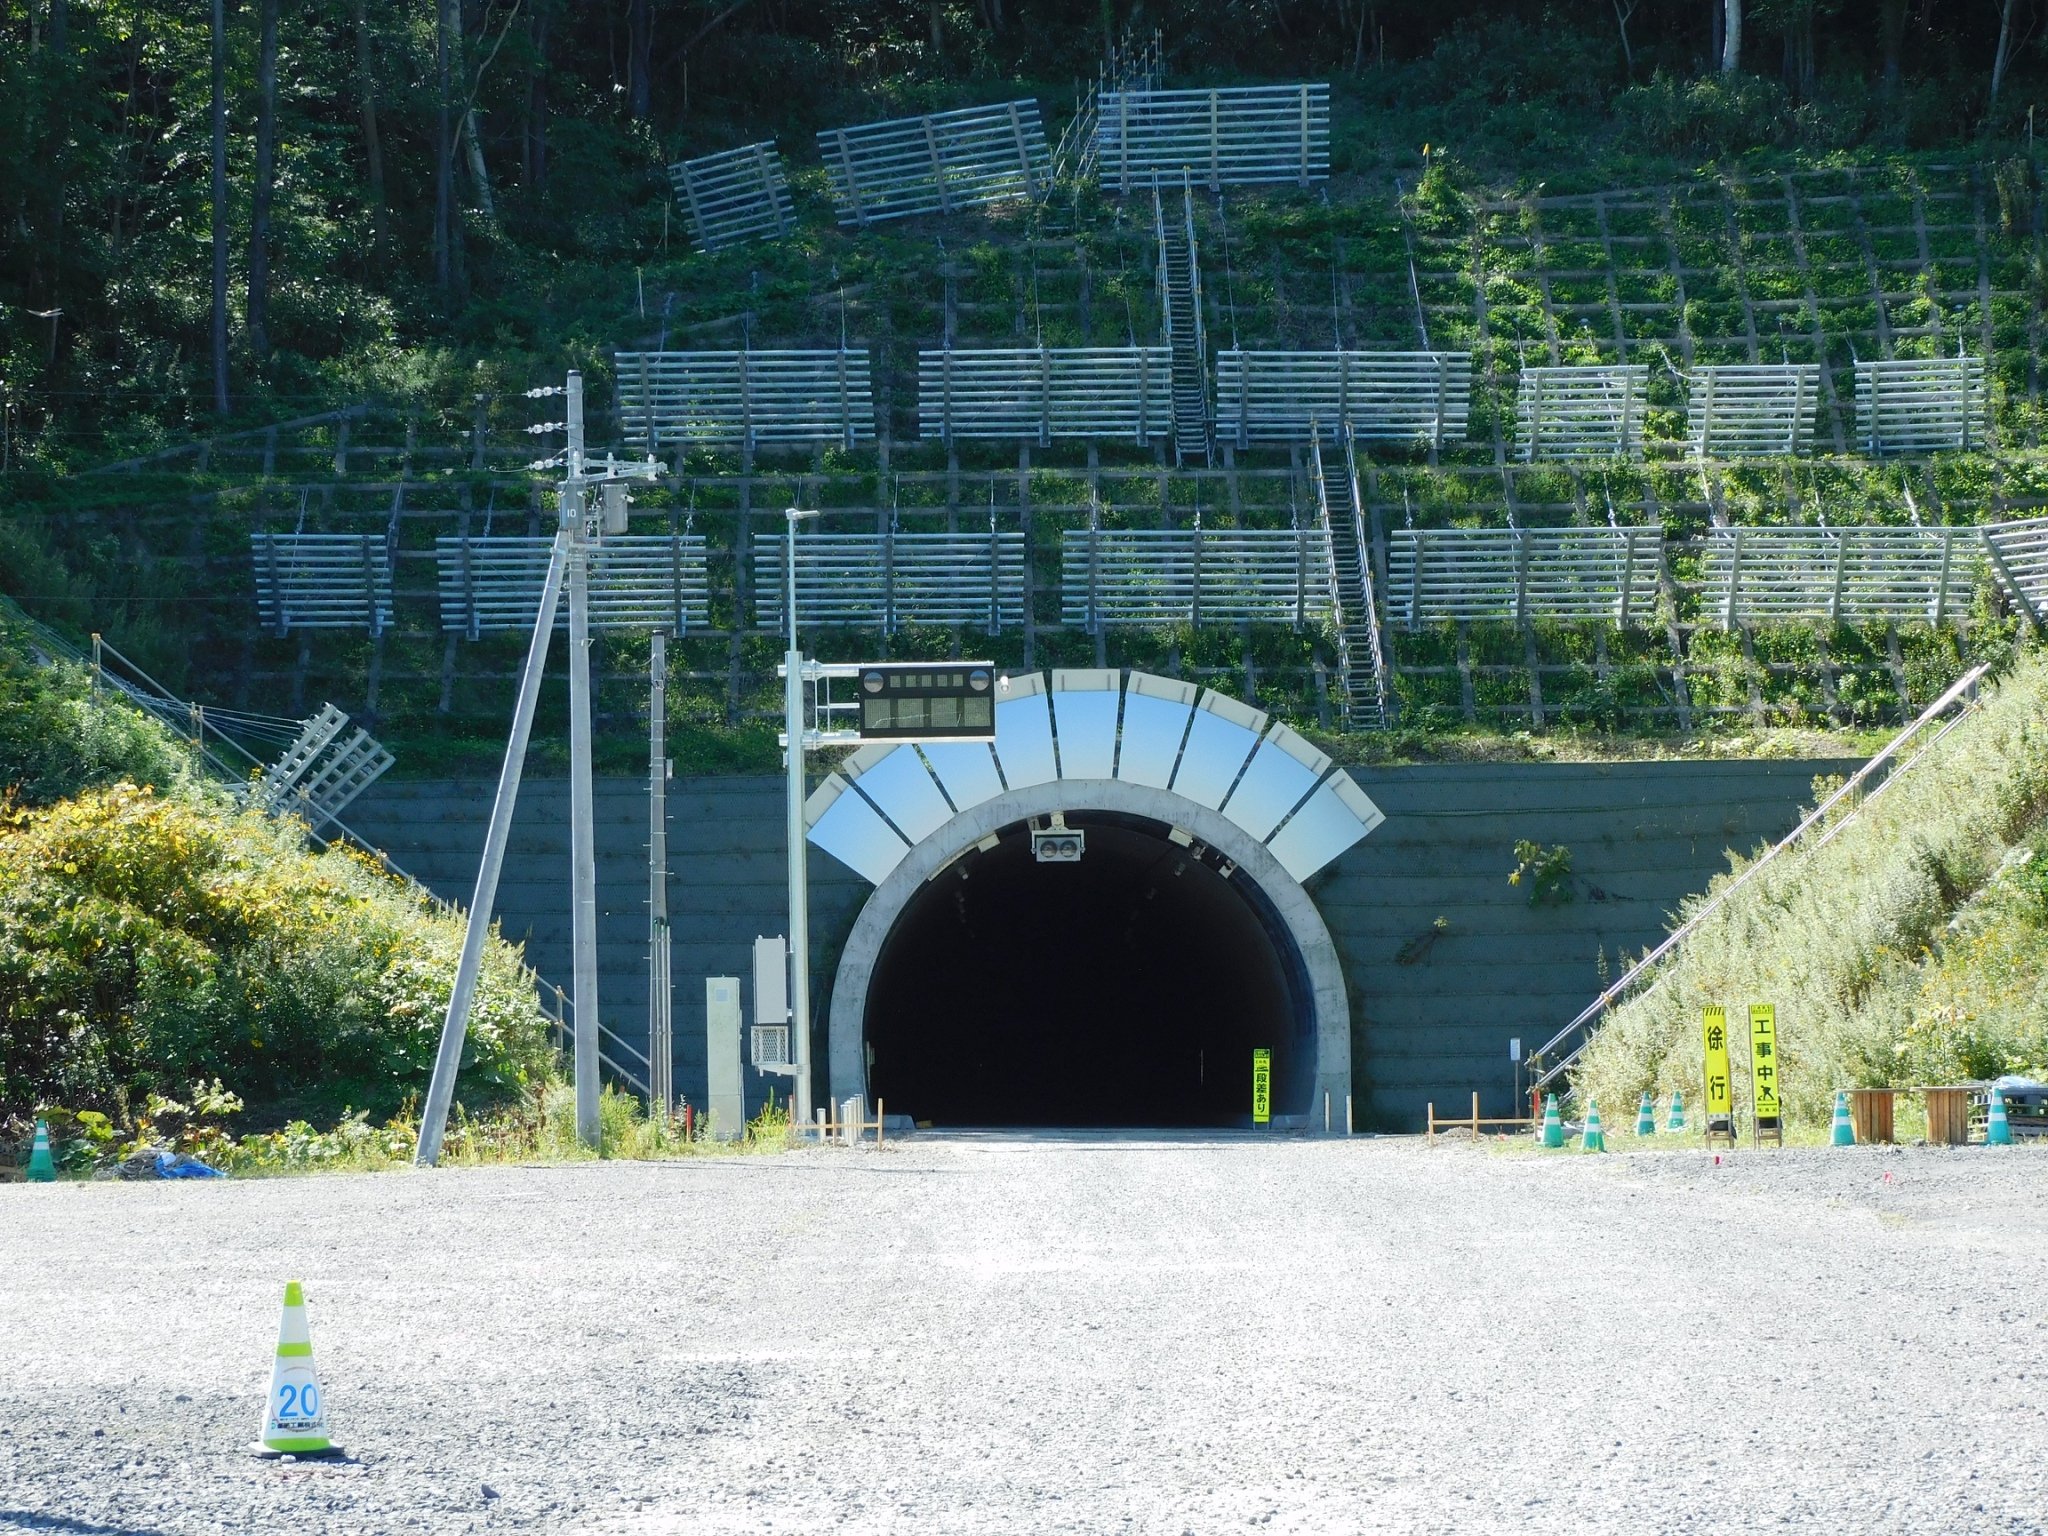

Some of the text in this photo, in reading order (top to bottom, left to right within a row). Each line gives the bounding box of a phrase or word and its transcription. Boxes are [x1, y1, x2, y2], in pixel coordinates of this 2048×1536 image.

[567, 508, 577, 518] 10
[1707, 1025, 1726, 1101] 徐行
[1754, 1019, 1773, 1081] 工事中
[1255, 1072, 1268, 1113] 段差あり
[279, 1383, 319, 1418] 20
